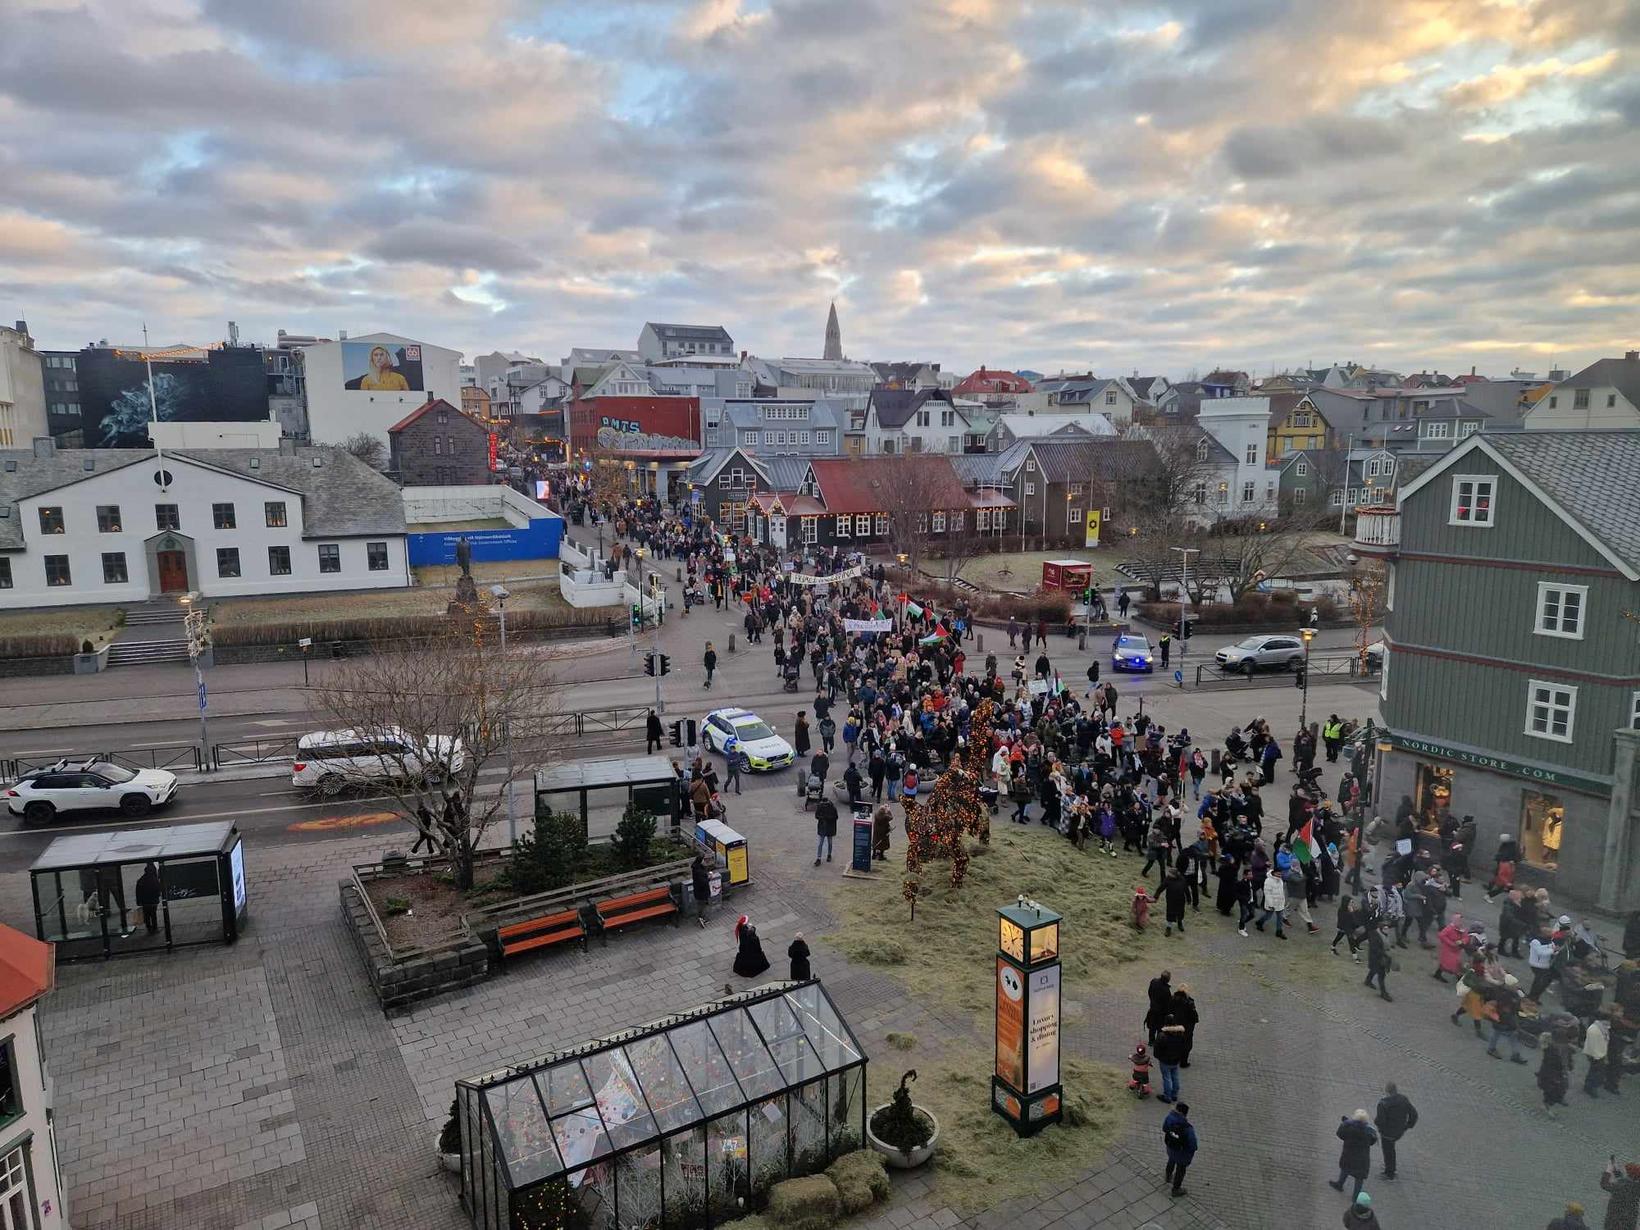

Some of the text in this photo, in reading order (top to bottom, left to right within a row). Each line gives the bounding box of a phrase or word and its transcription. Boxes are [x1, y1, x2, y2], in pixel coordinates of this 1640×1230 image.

[1402, 740, 1556, 780] NORDIC STORE .COM
